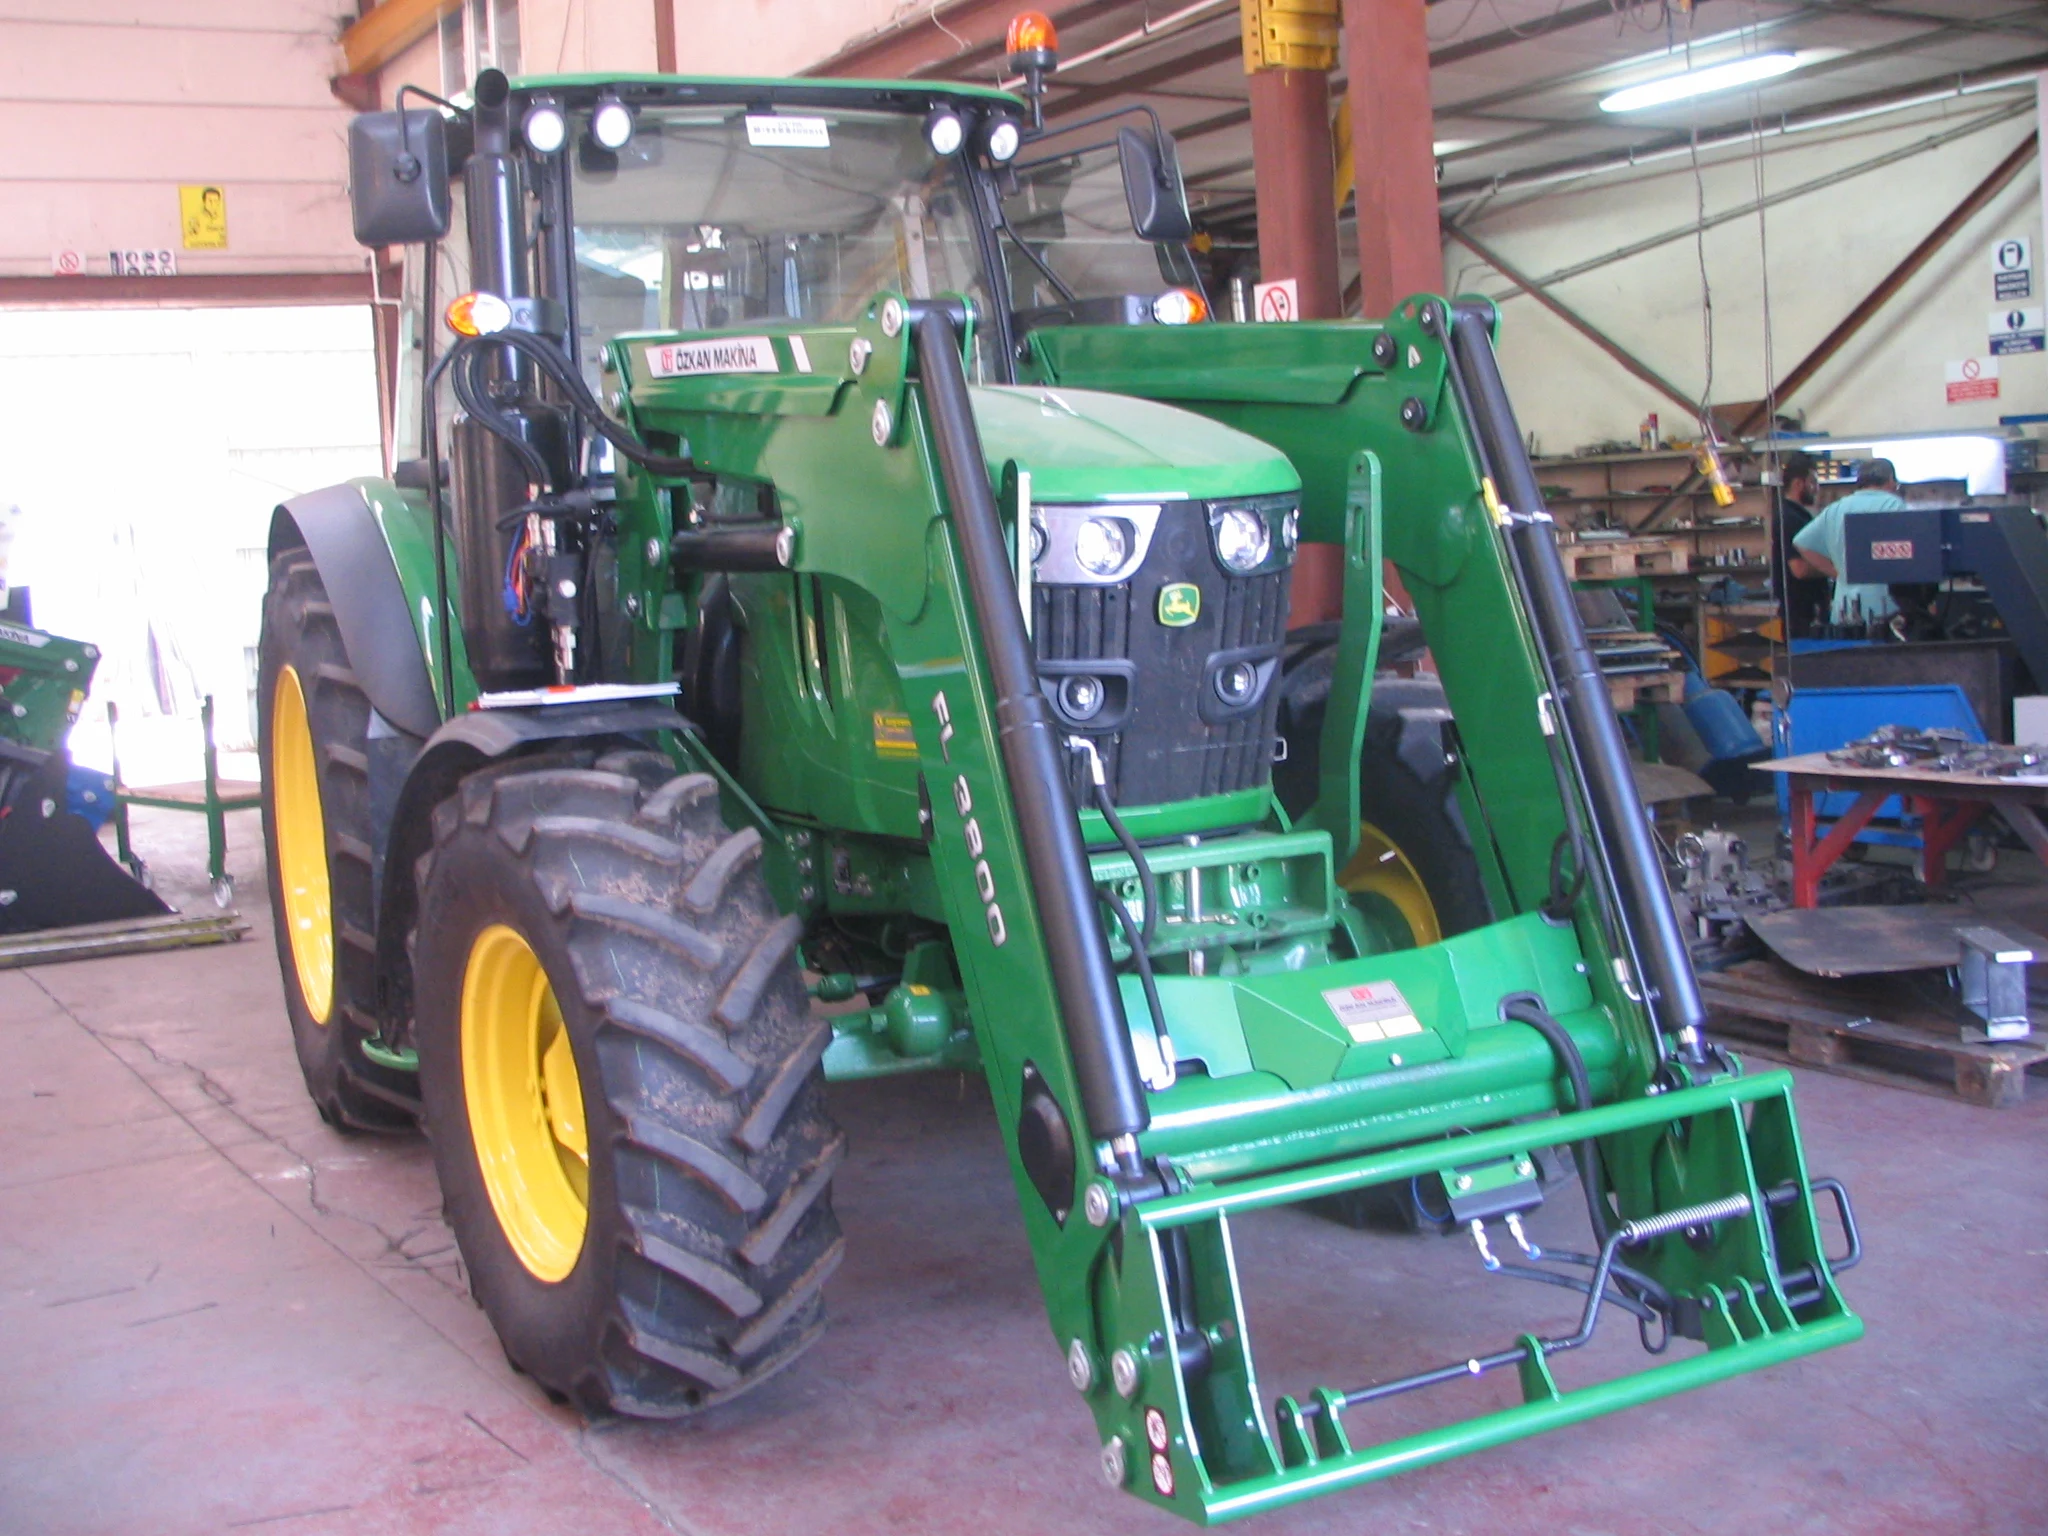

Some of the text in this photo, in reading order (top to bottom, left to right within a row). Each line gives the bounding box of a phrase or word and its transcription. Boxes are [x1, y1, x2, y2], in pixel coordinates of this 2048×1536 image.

[676, 342, 757, 371] ÖZKAN MAKİNA
[931, 690, 1008, 949] FL 3800
